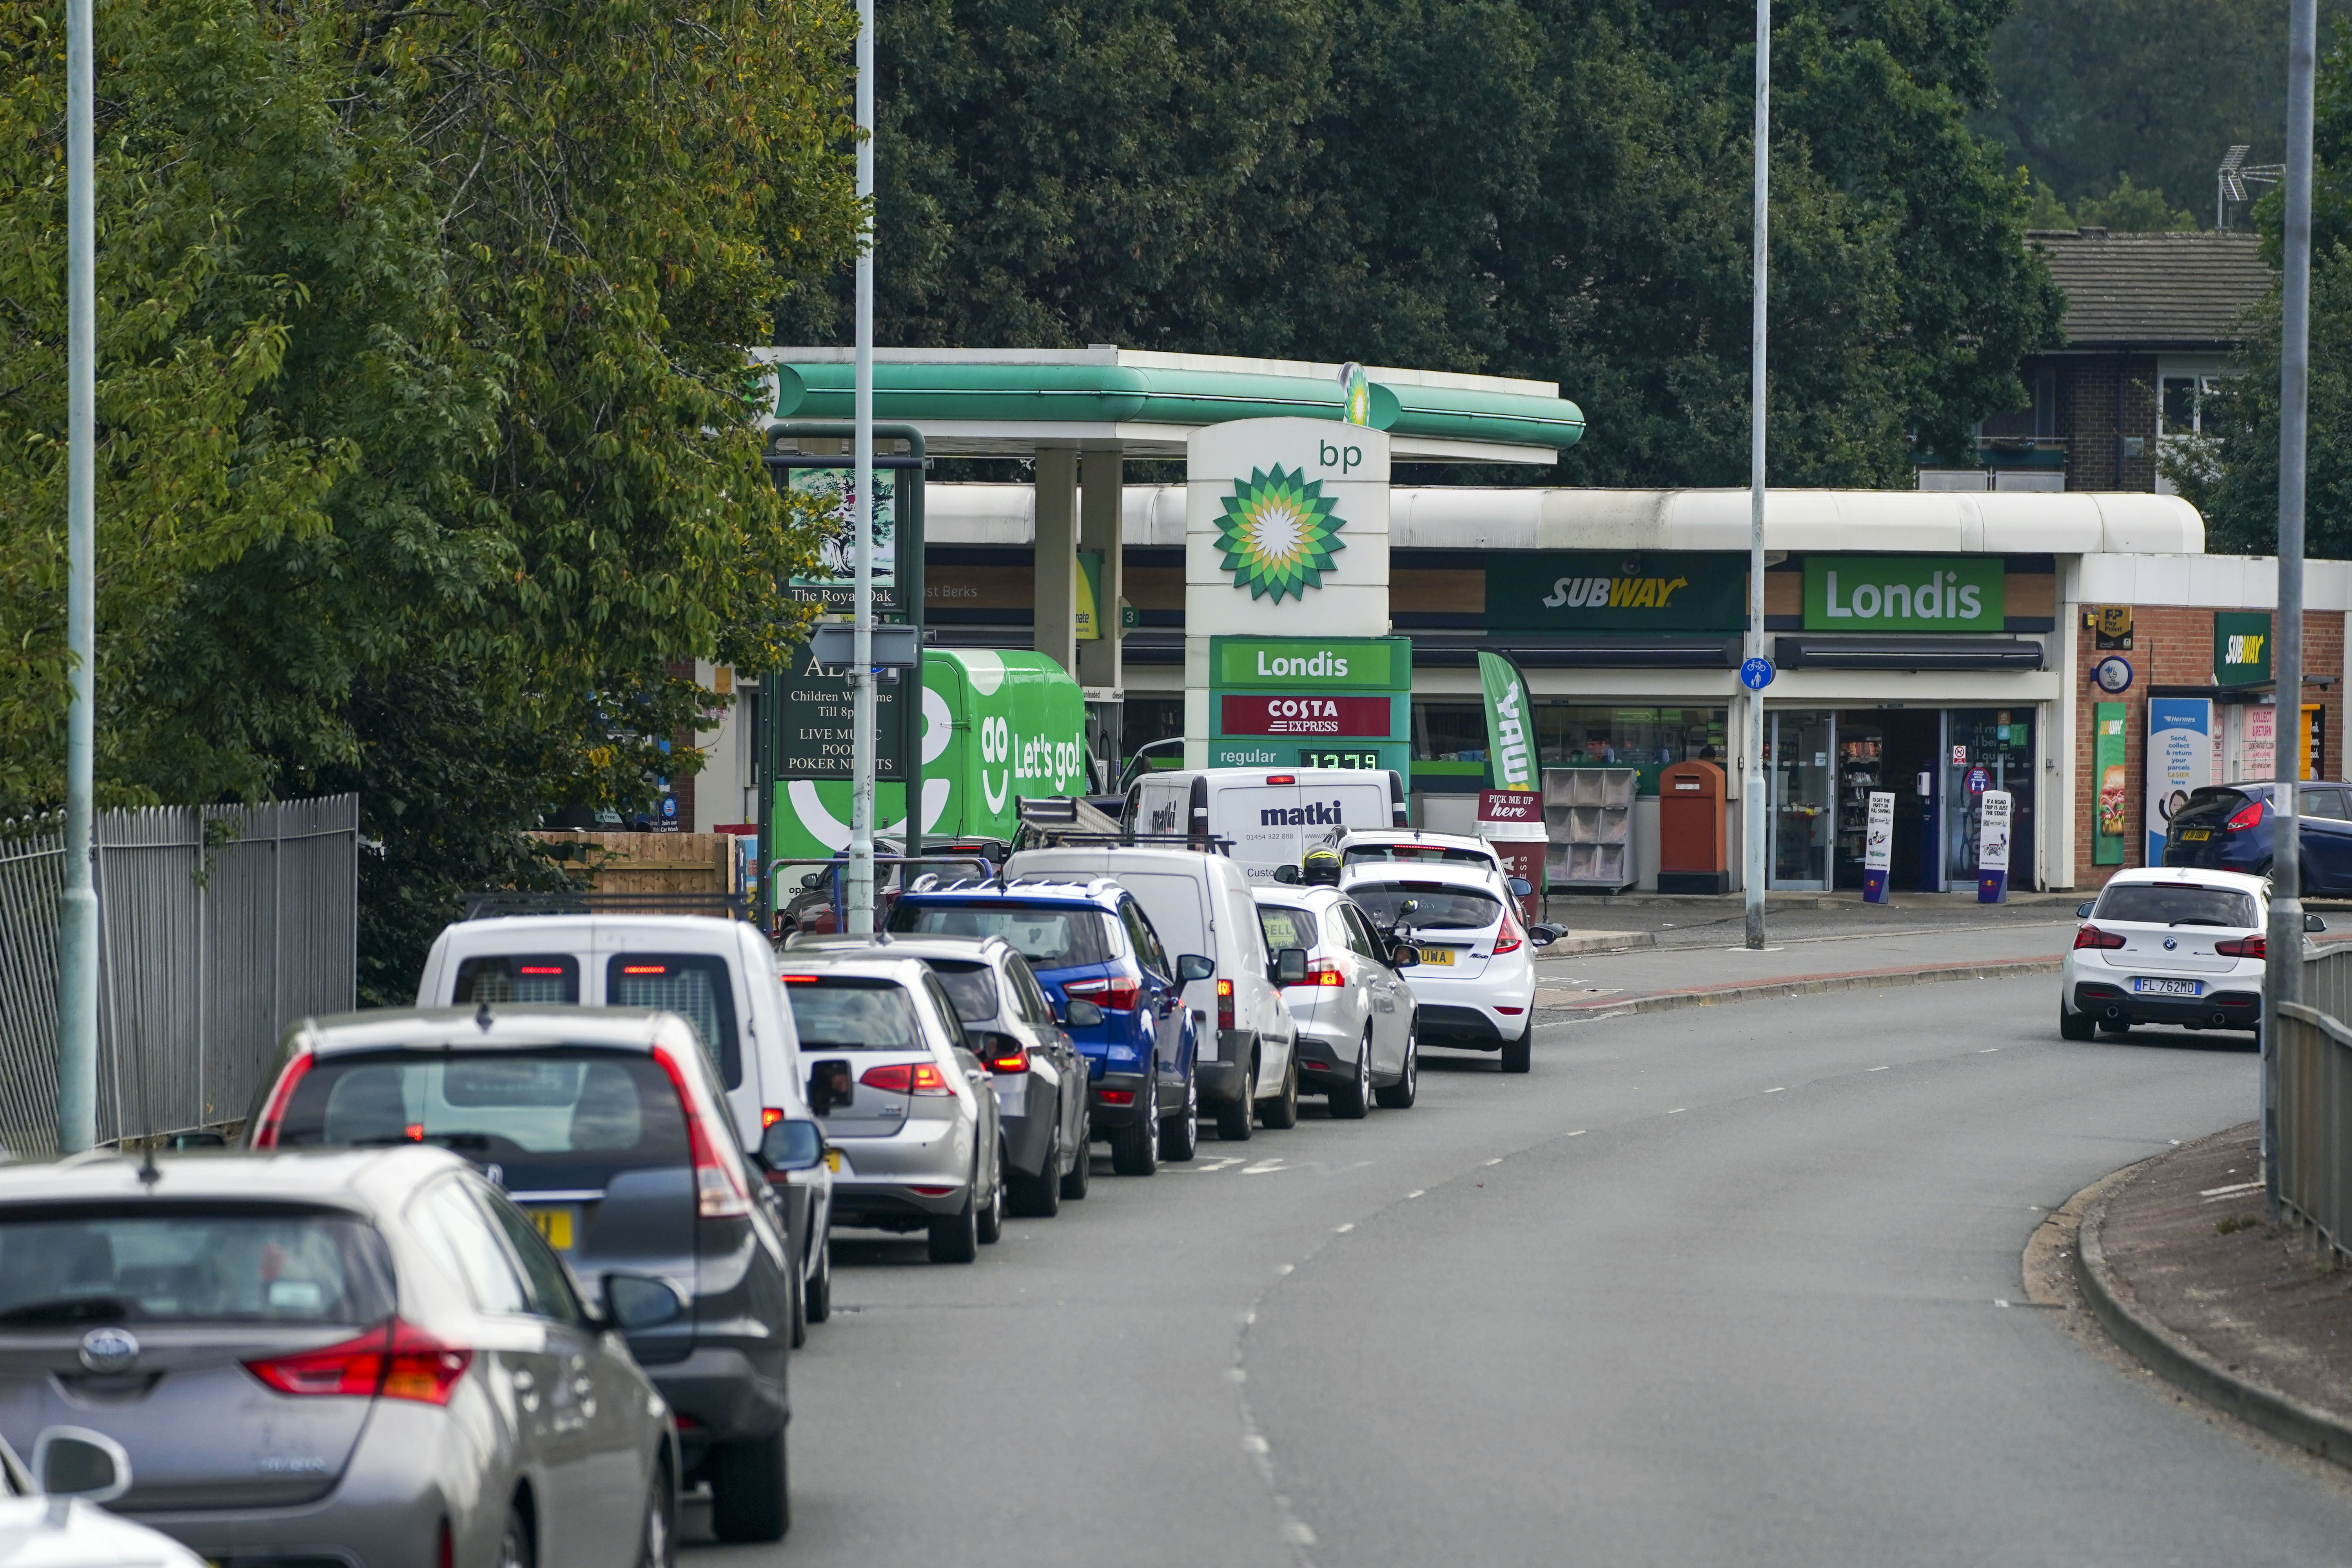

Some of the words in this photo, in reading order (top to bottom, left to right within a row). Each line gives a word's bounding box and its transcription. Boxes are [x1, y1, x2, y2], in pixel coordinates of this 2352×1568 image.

[1320, 439, 1362, 474] bp
[791, 589, 817, 601] The
[822, 590, 855, 604] Roya
[943, 585, 977, 597] Berks
[1543, 575, 1688, 608] SUBWAY
[1827, 570, 1982, 619] Londis
[1126, 611, 1134, 623] 3
[2225, 633, 2264, 664] SUBWAY
[1258, 651, 1348, 677] Londis
[791, 691, 838, 701] Children
[818, 706, 837, 717] Till
[841, 707, 854, 719] 8p
[1268, 700, 1338, 719] COSTA
[2253, 711, 2272, 722] COLLECT
[800, 729, 832, 739] LIVE
[1289, 721, 1338, 732] EXPRESS
[2100, 719, 2123, 735] SUBWAY
[2252, 726, 2255, 736] &
[2256, 726, 2272, 736] RETURN
[982, 716, 1008, 763] ao
[788, 758, 836, 769] POKER
[840, 759, 892, 769] NITS
[1014, 733, 1053, 778] Let's
[1055, 732, 1080, 792] go!
[1220, 749, 1276, 766] regular
[1489, 794, 1506, 804] PICK
[1508, 795, 1521, 804] ME
[1523, 796, 1533, 805] UP
[1152, 800, 1176, 835] matki
[1261, 800, 1341, 826] matki
[1491, 802, 1527, 818] here
[1264, 924, 1293, 935] SELL
[1421, 950, 1446, 963] UWA
[2142, 980, 2155, 991] FL
[2160, 980, 2194, 993] 762MD
